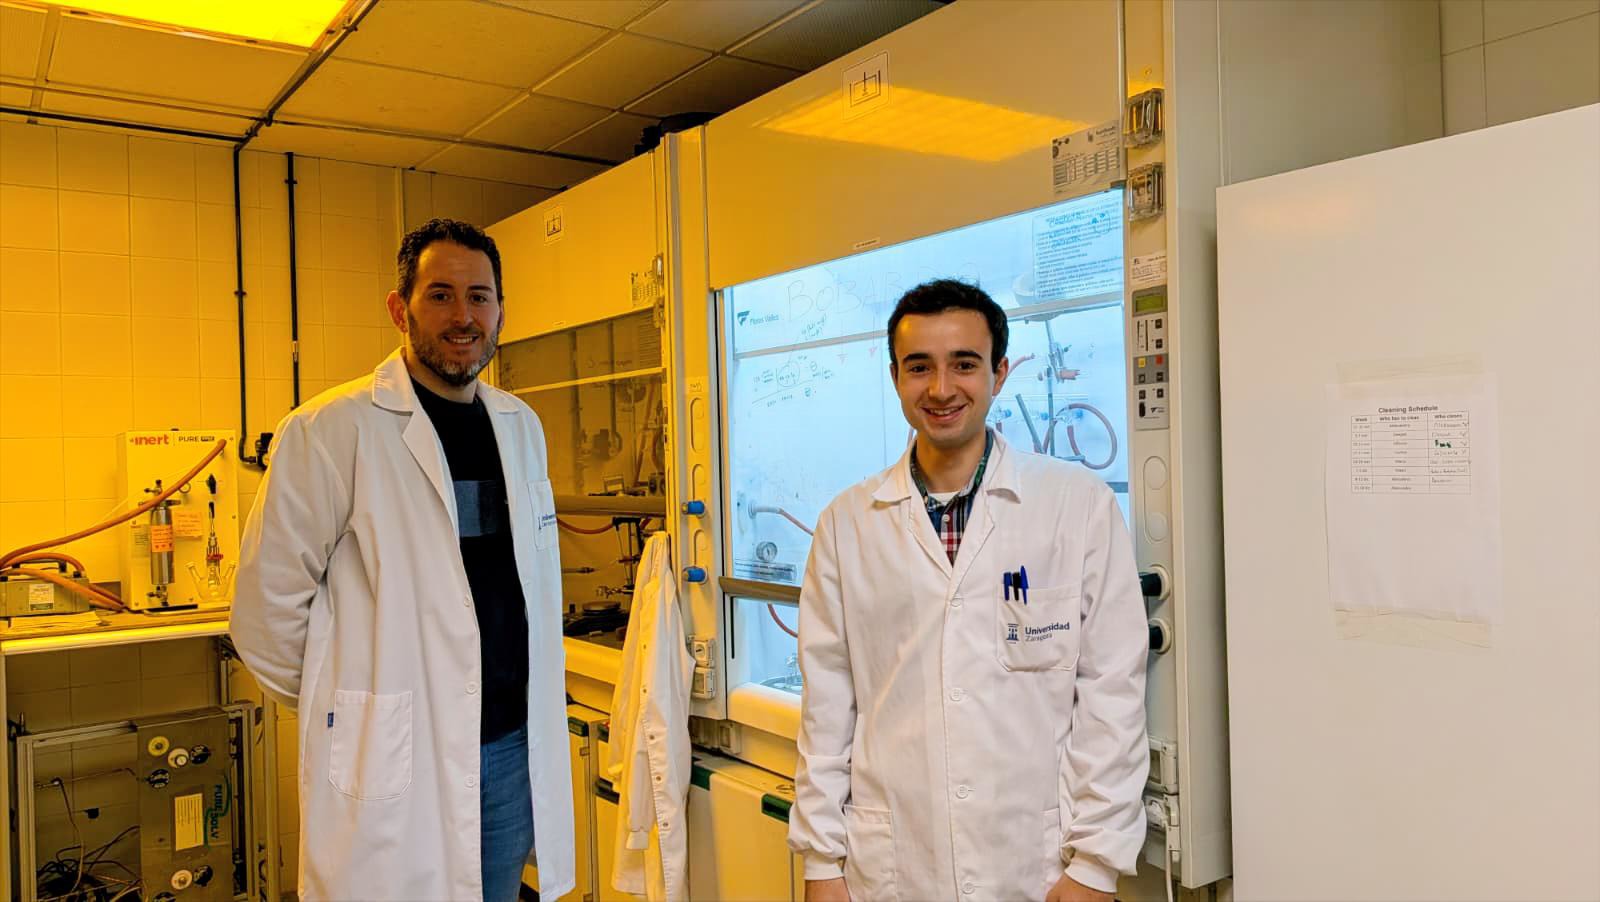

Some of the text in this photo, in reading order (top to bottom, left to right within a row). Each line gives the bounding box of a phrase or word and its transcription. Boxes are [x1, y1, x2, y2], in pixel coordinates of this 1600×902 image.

[1378, 406, 1407, 414] Cleaning
[134, 434, 169, 445] inert
[178, 435, 200, 443] PURE
[1025, 622, 1070, 635] Universidad
[1025, 633, 1052, 642] Zaragoza
